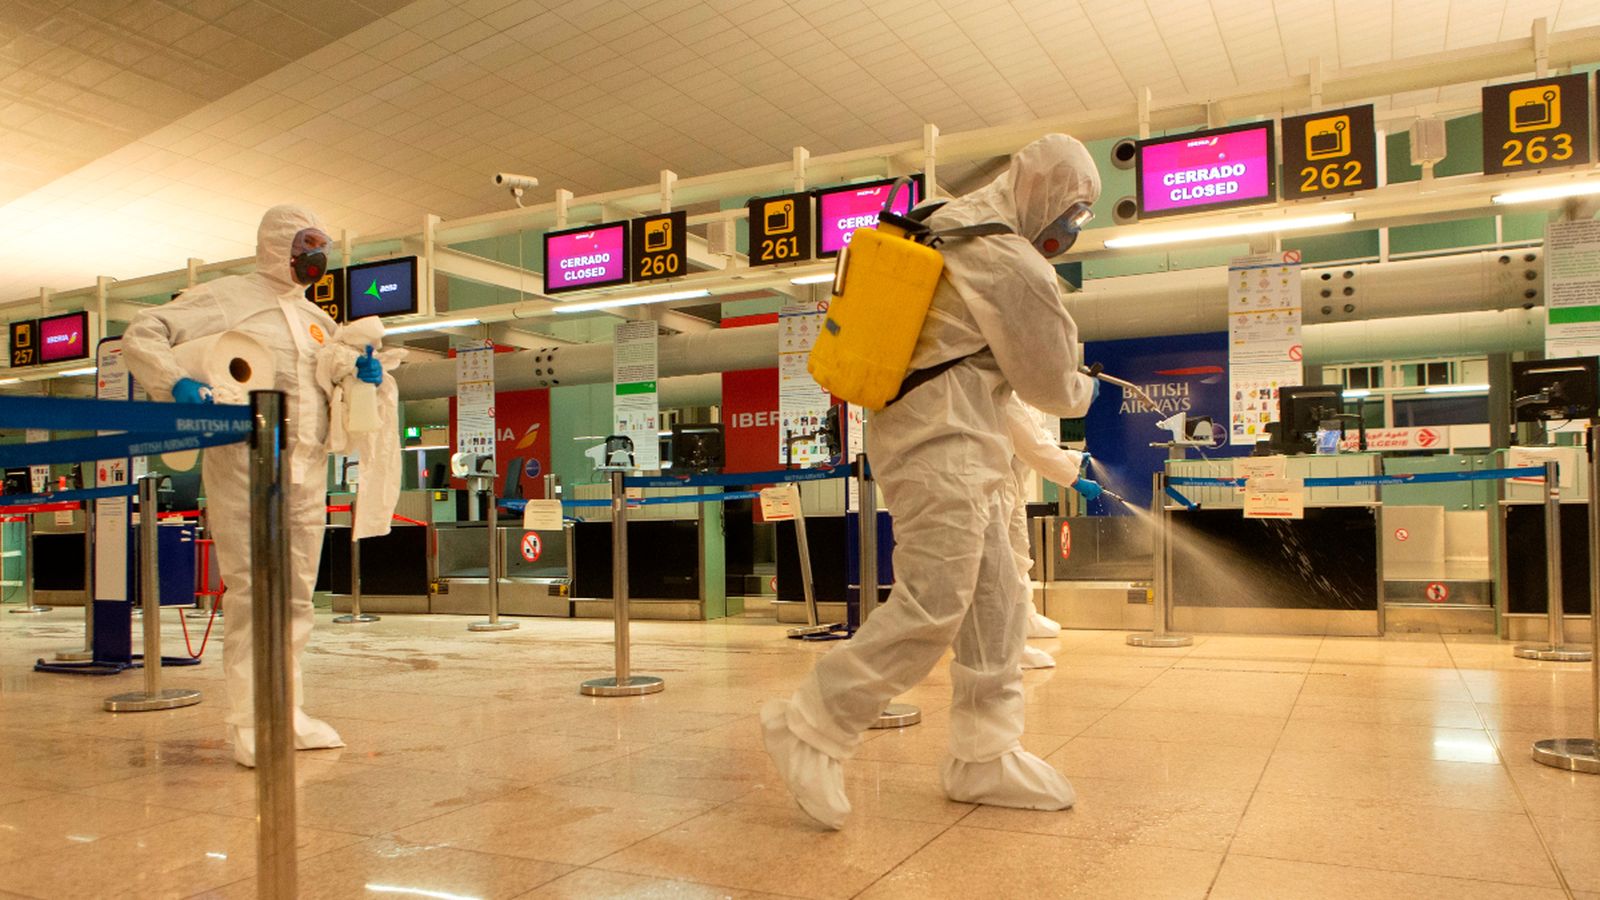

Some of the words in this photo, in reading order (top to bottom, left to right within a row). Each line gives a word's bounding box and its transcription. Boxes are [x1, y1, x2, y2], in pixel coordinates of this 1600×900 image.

[1502, 133, 1574, 167] 263
[1163, 163, 1246, 186] CERRADO
[1300, 160, 1362, 192] 262
[1170, 181, 1239, 201] CLOSED
[761, 236, 800, 261] 261
[560, 253, 610, 269] CERRADO
[640, 253, 679, 277] 260
[564, 267, 606, 281] CLOSED
[14, 349, 33, 365] 257
[176, 418, 230, 432] BRITISH
[731, 410, 780, 428] IBER
[128, 440, 162, 455] BRITISH
[163, 437, 200, 450] AIRWAYS
